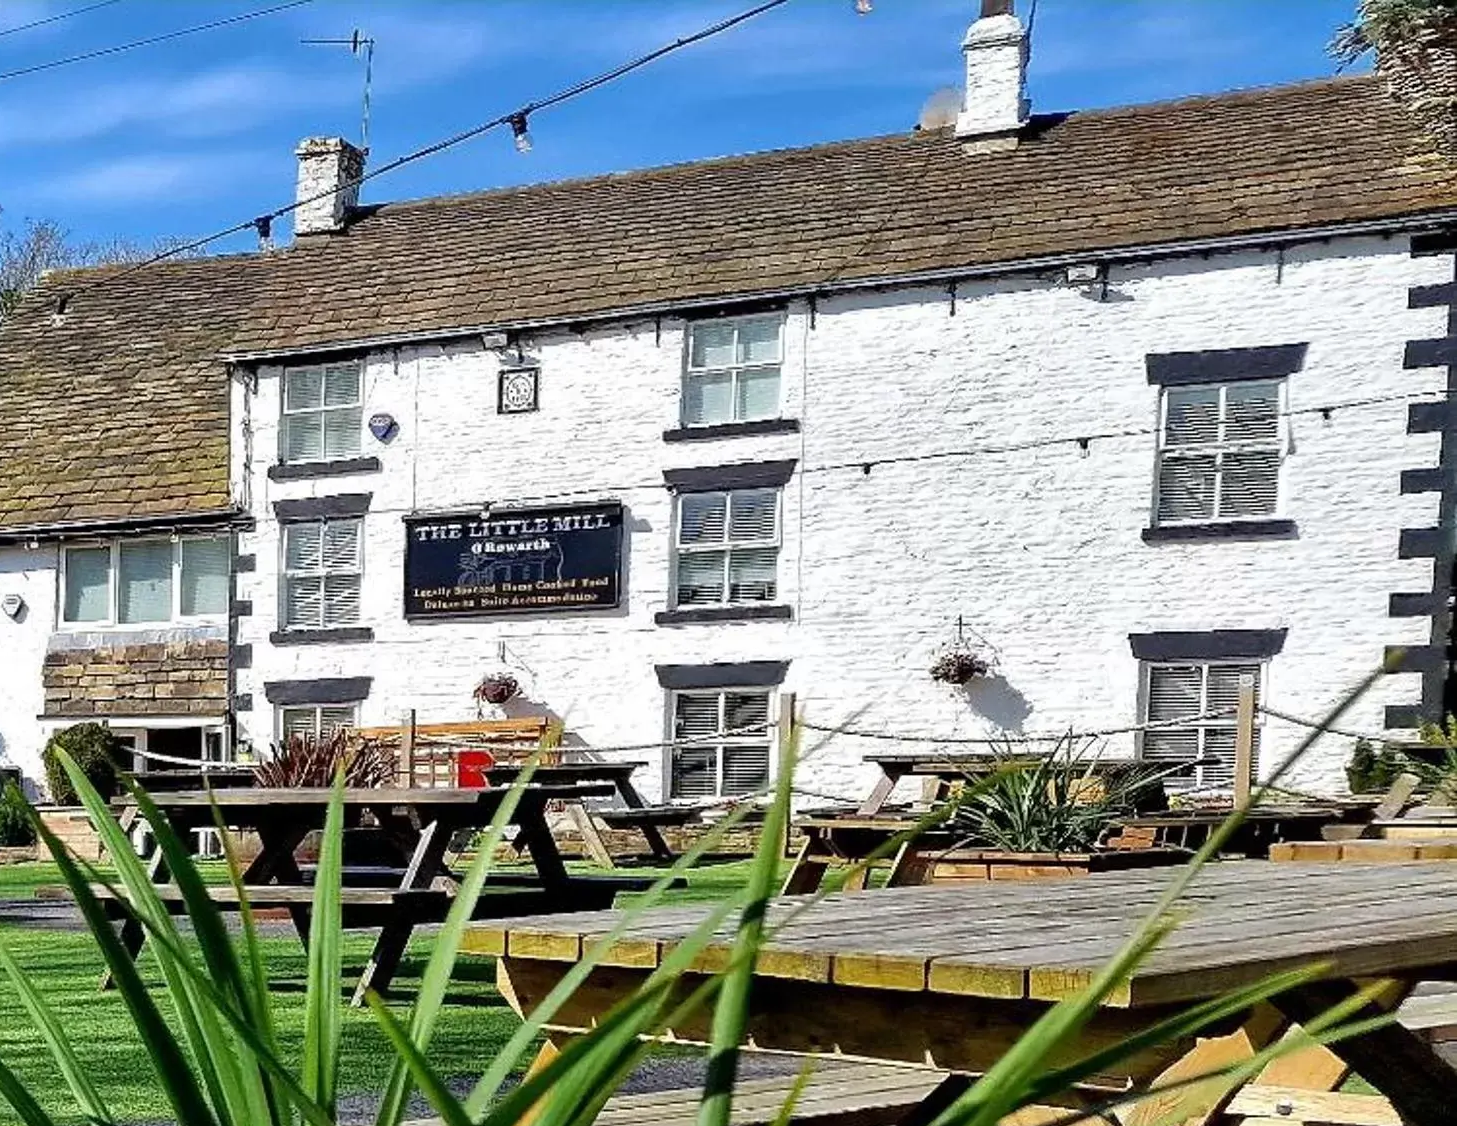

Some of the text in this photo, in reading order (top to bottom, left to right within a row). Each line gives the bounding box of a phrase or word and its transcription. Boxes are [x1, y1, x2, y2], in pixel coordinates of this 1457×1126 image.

[415, 514, 611, 541] THE LITTLE MILL
[413, 586, 452, 598] Locally
[502, 581, 533, 592] Home
[535, 579, 576, 590] Cooked
[581, 576, 609, 588] Food
